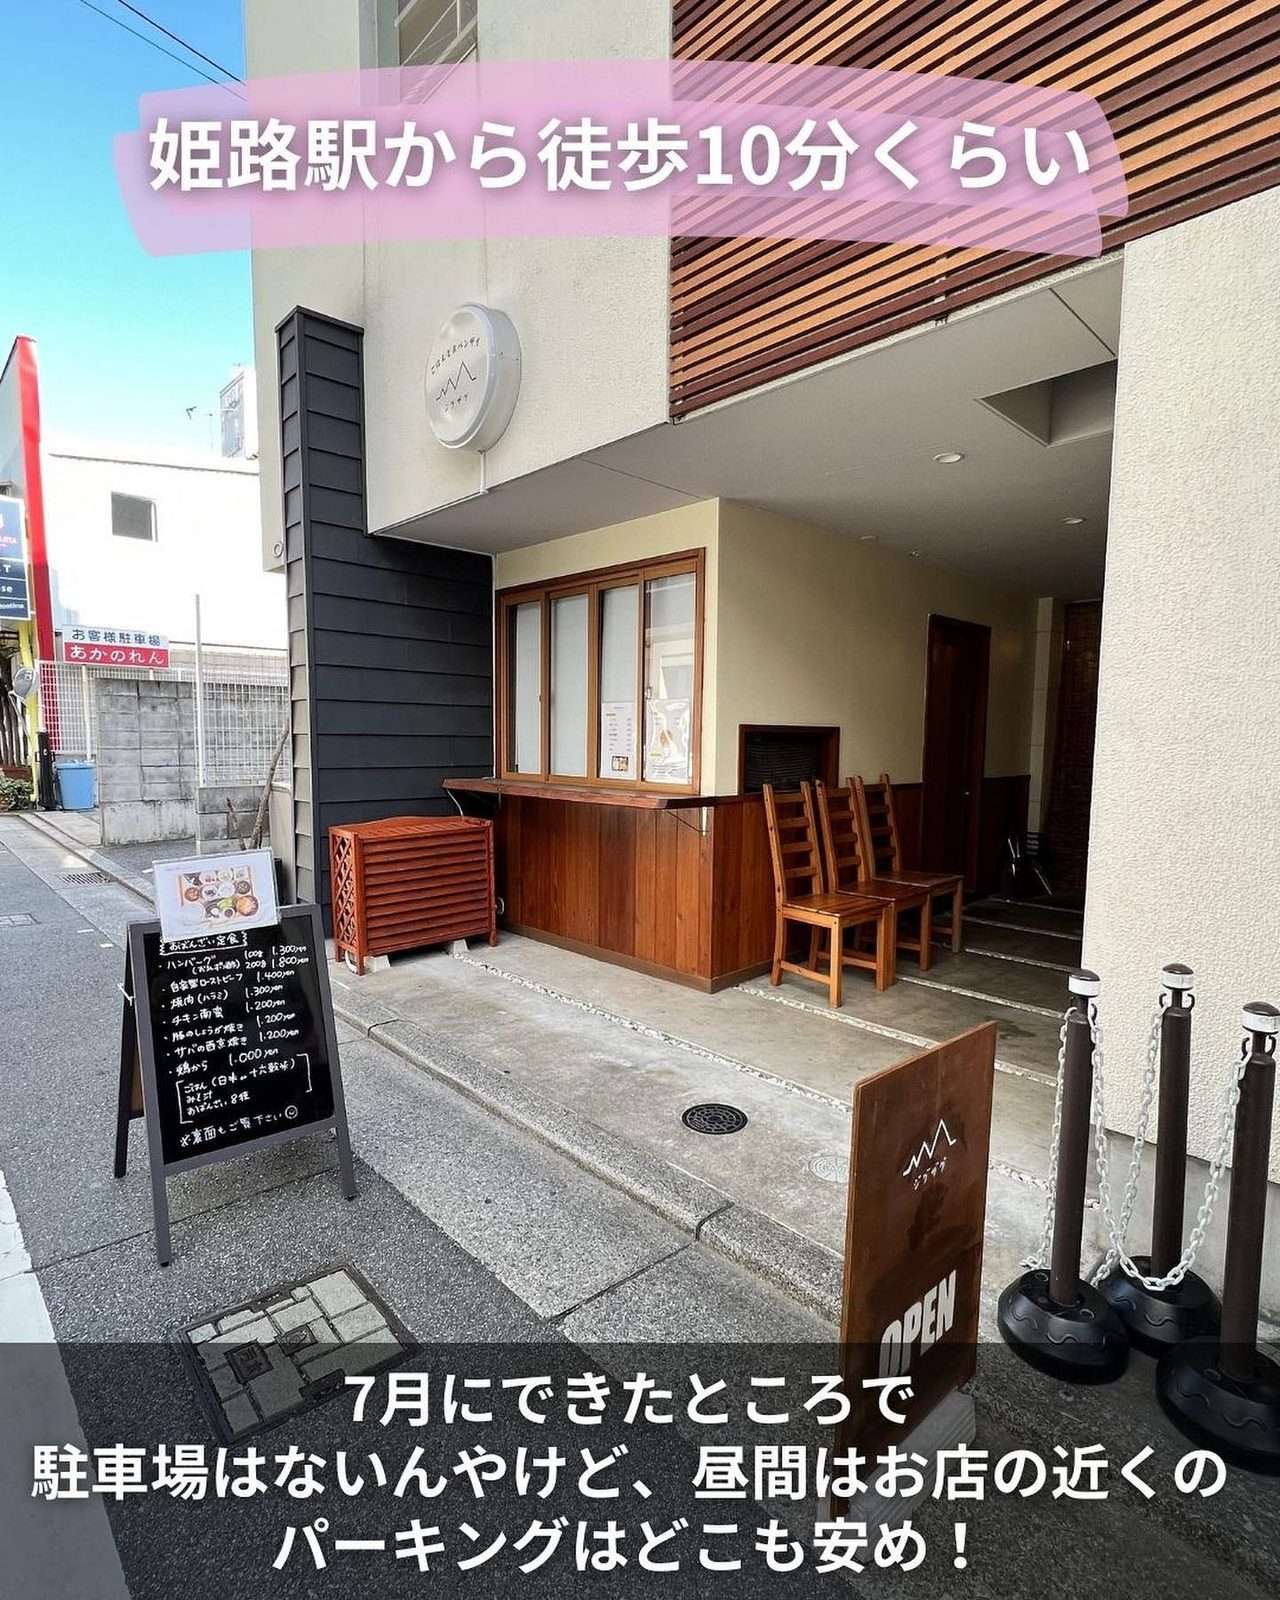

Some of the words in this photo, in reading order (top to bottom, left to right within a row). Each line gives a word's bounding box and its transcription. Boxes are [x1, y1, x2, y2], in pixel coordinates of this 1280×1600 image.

[71, 628, 161, 647] お客様駐車場
[70, 644, 164, 665] あかのれん
[167, 954, 217, 970] ハンバーグ
[171, 1005, 224, 1026] チキン南蛮
[879, 1269, 957, 1377] OPEN
